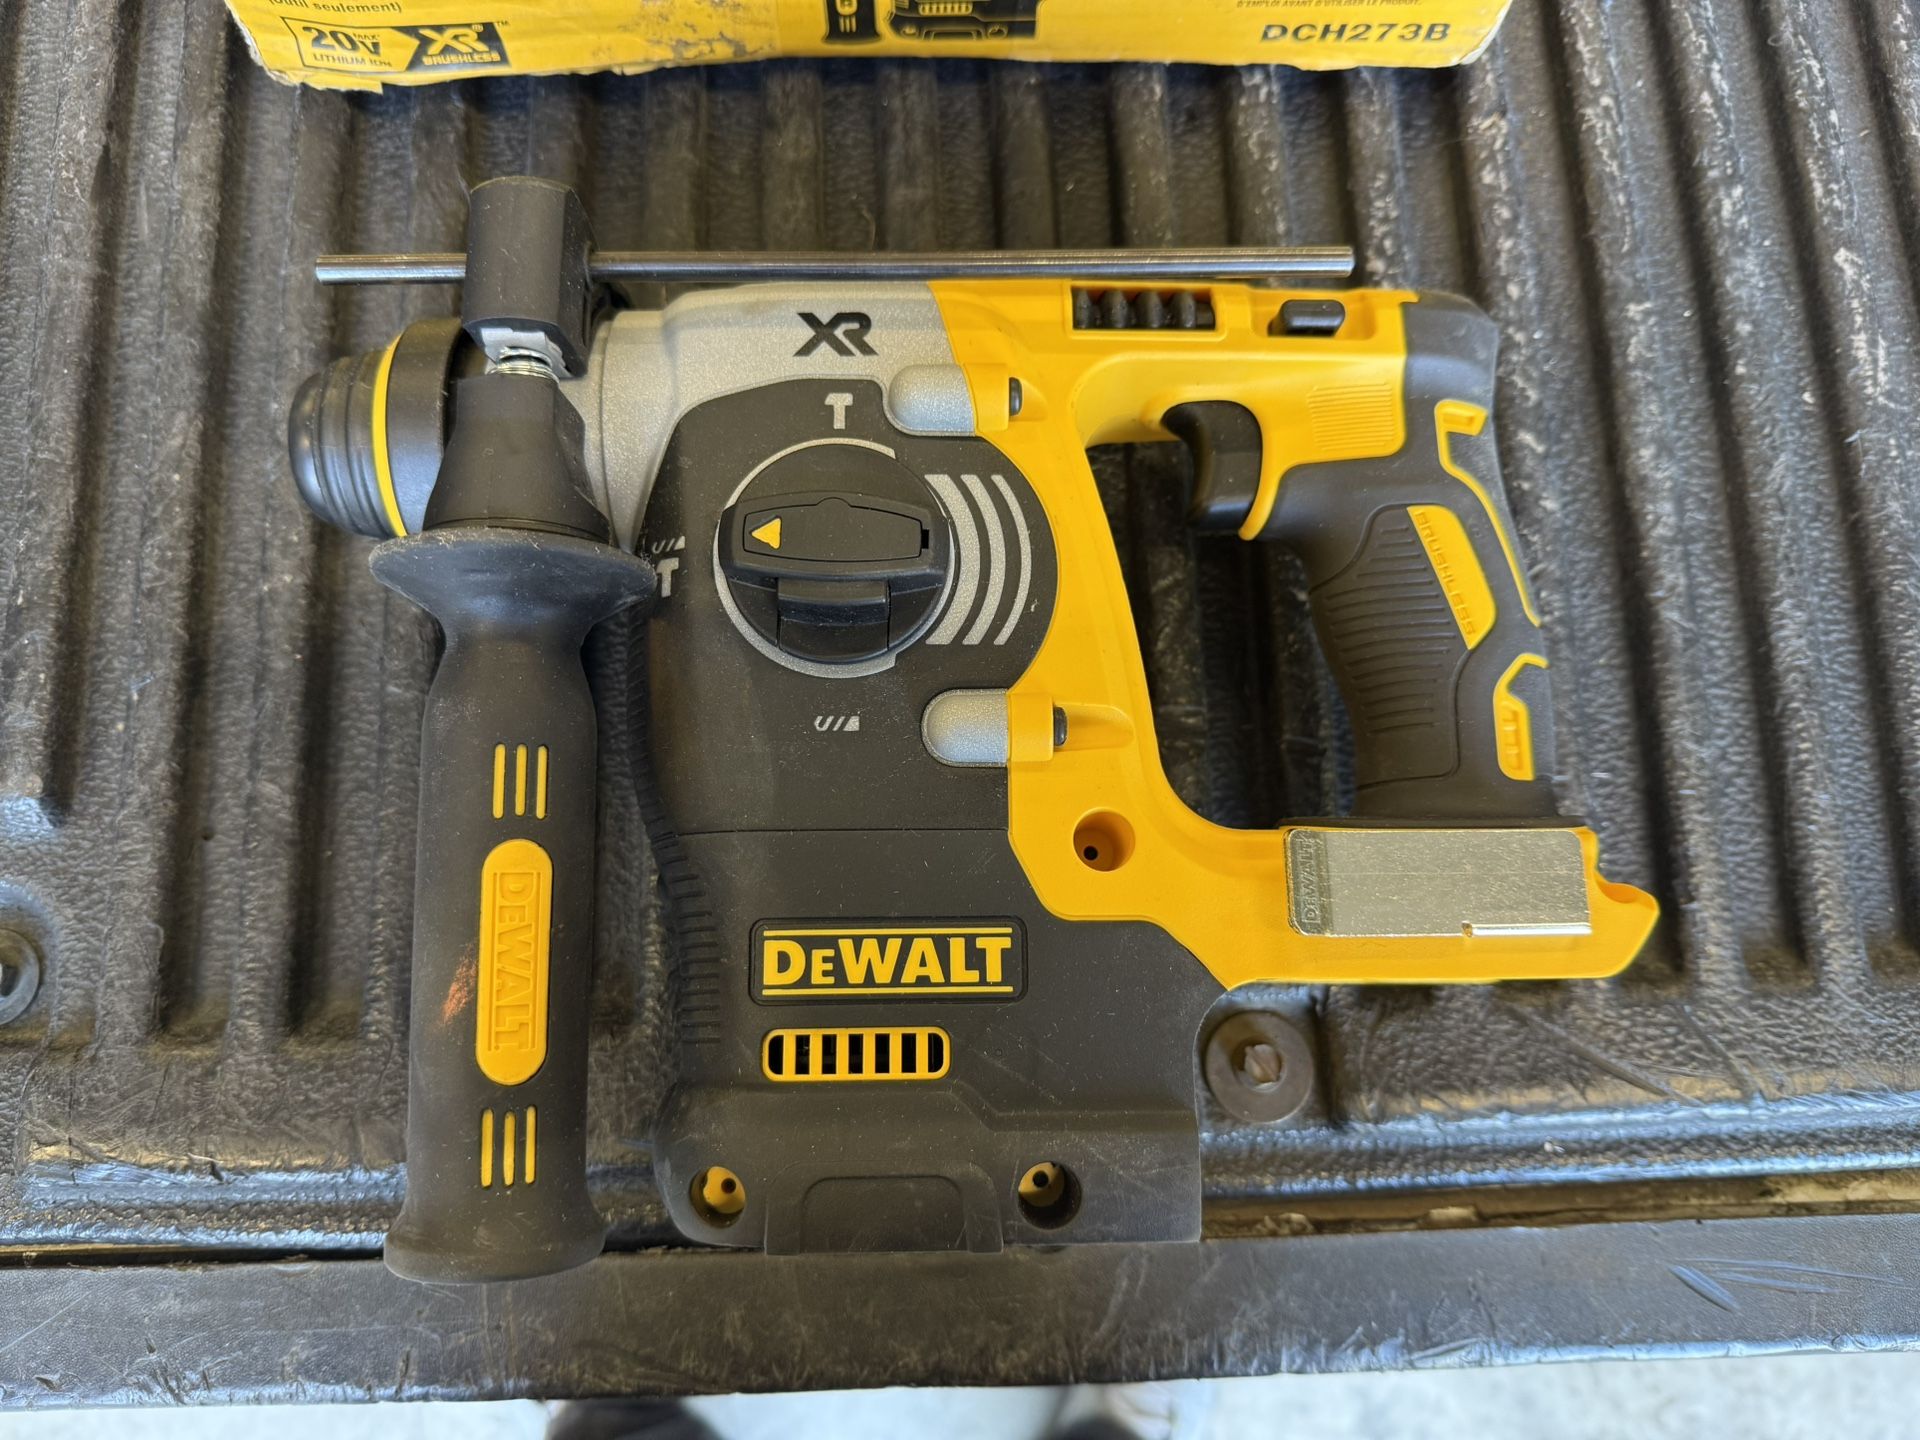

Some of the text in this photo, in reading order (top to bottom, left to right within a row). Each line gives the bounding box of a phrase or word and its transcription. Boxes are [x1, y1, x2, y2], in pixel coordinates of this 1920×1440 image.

[313, 2, 402, 13] seulement)
[418, 27, 490, 56] XR
[1260, 23, 1451, 43] DCH273B
[313, 53, 366, 66] LITHIUM
[422, 53, 501, 66] BRUSHLESS
[793, 312, 879, 357] XR
[1414, 510, 1475, 636] BRUSHLESS
